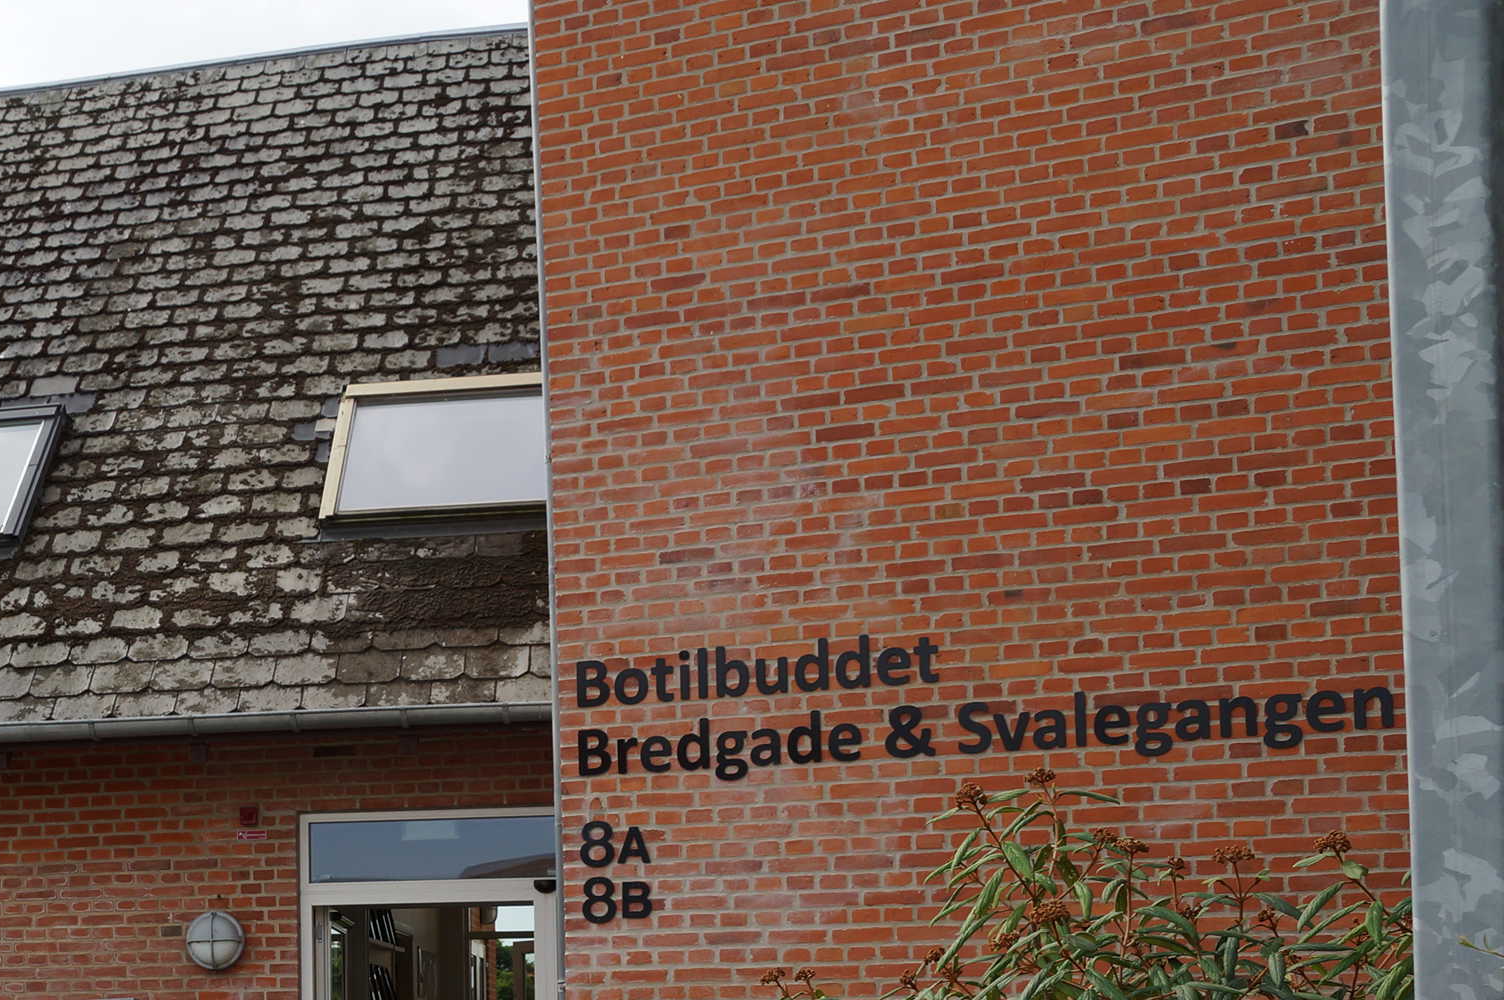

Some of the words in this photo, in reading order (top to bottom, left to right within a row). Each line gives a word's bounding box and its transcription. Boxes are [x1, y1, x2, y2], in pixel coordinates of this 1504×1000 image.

[575, 634, 939, 709] Botilbuddet
[577, 710, 863, 782] Bredgade
[884, 704, 937, 760] &
[957, 686, 1396, 758] Svalegangen
[579, 820, 652, 869] 8A
[582, 876, 654, 925] 8B
